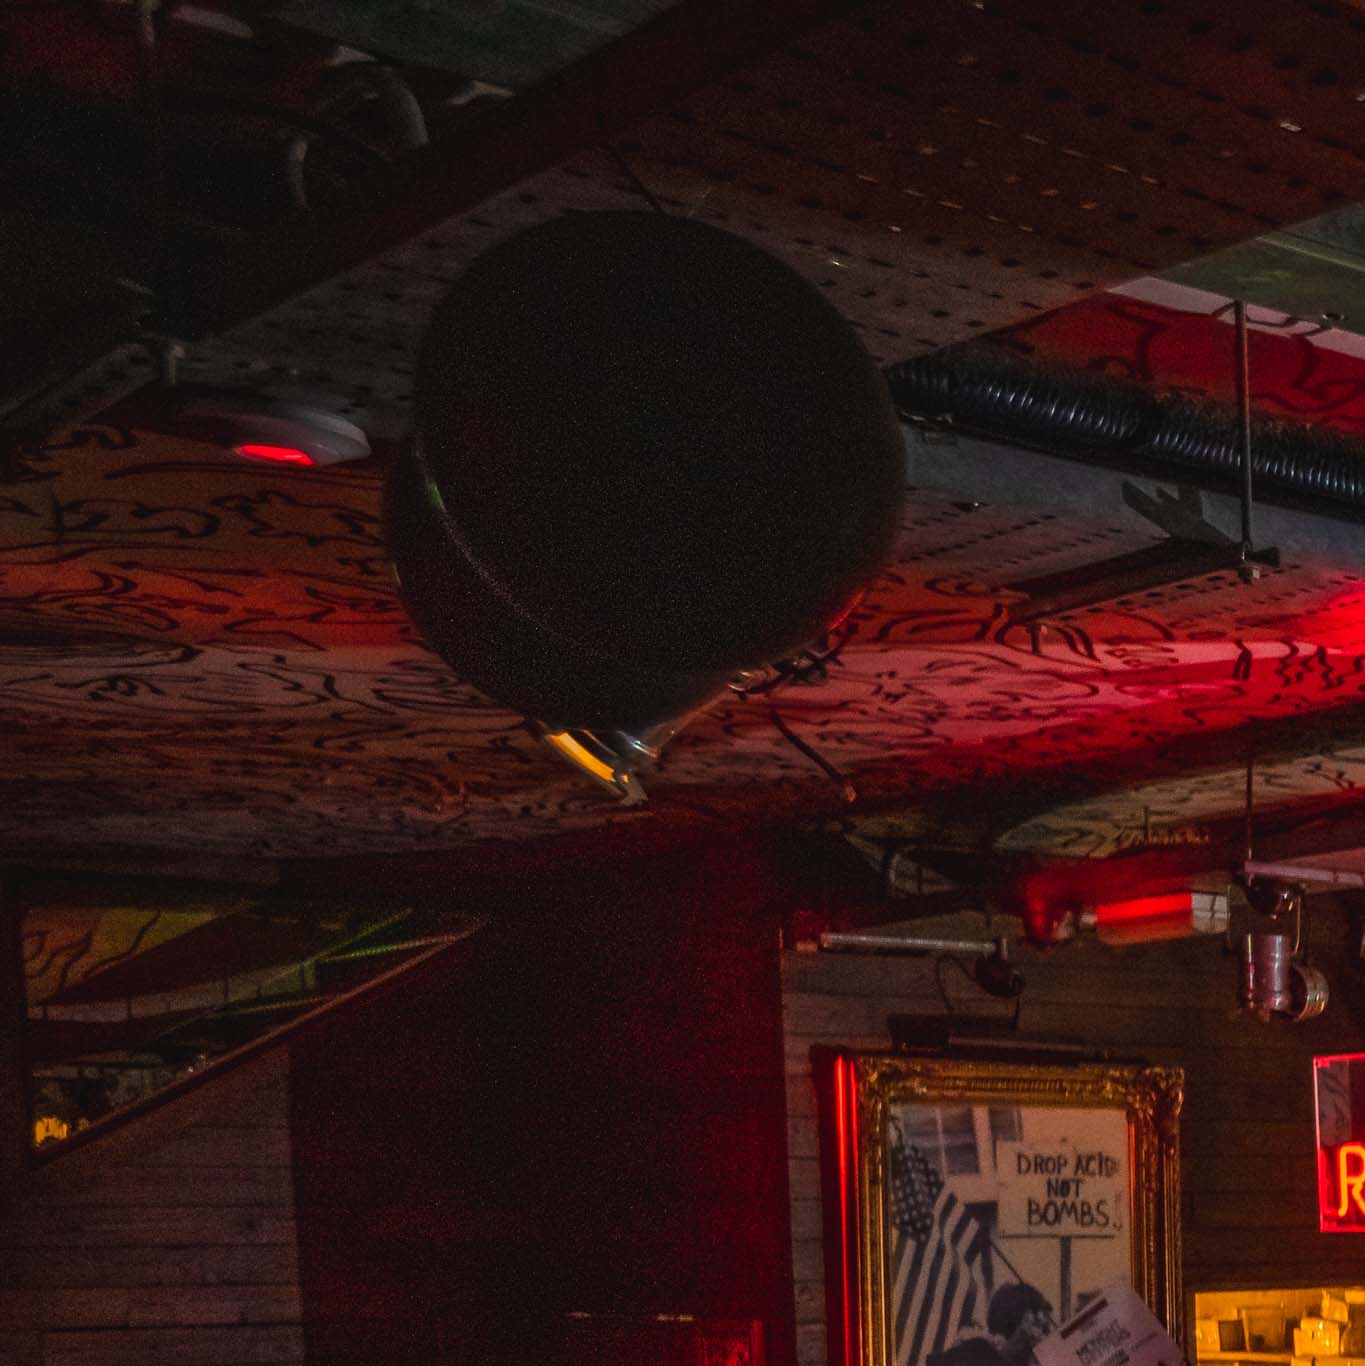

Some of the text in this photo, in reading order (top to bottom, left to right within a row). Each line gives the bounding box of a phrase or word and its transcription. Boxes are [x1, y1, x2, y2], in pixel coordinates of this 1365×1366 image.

[1016, 1151, 1120, 1178] DROP ACID
[1046, 1177, 1087, 1198] NOT
